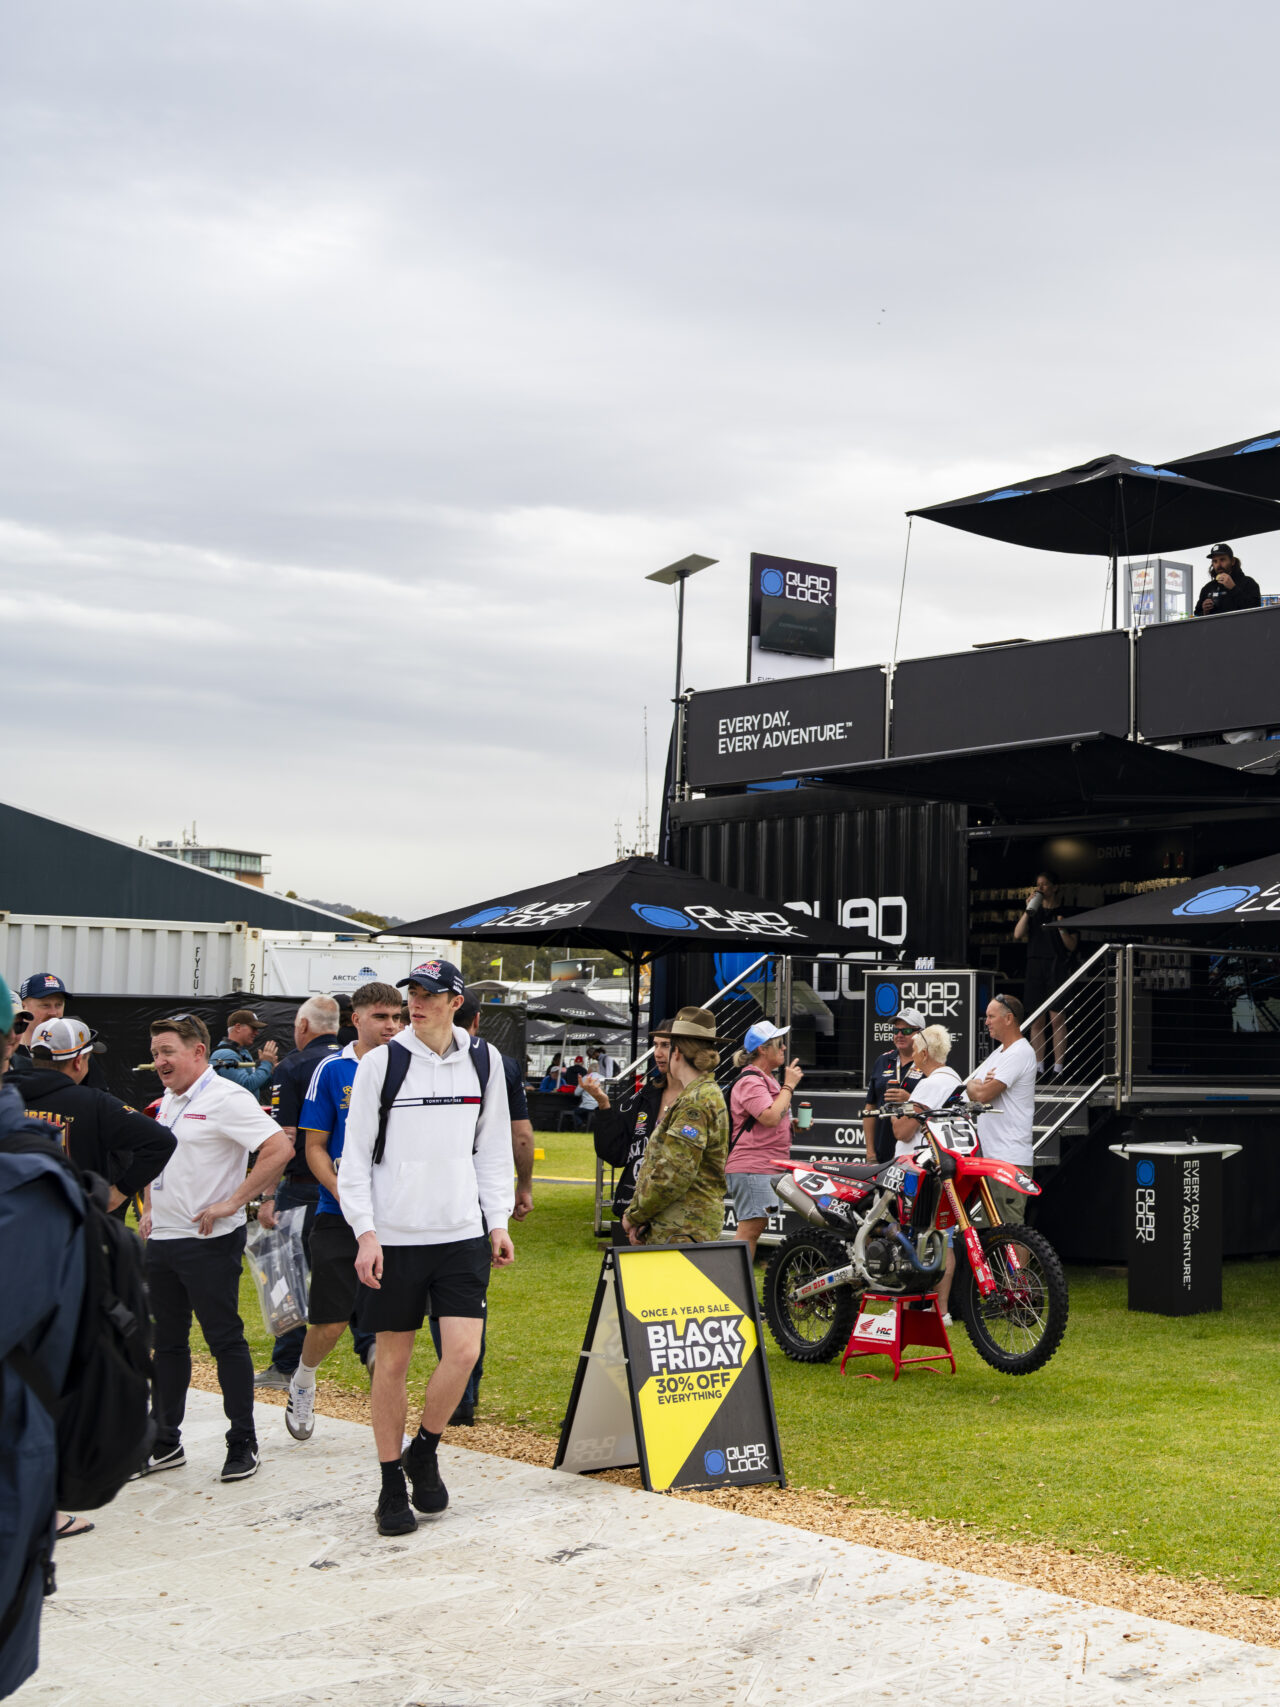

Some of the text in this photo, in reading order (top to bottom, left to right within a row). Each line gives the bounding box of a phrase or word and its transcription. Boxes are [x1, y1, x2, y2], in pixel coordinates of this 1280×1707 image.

[786, 571, 830, 591] QUAD
[785, 585, 831, 605] LOCK
[718, 710, 790, 735] EVERY DAY.
[718, 734, 760, 754] EVERY
[1097, 845, 1132, 858] DRIVE
[512, 901, 591, 914] QUAD
[683, 905, 790, 926] QUAD
[480, 913, 568, 927] LOCK
[698, 918, 808, 938] LOCK
[901, 982, 959, 999] QUAD
[874, 1023, 894, 1032] EVER
[874, 1032, 894, 1041] EVER
[941, 1123, 974, 1149] 15
[796, 1172, 829, 1192] 15
[886, 1166, 905, 1181] QUAD
[1183, 1160, 1191, 1202] EVERY
[882, 1176, 902, 1192] LOCK
[1136, 1188, 1146, 1241] LOCK
[1145, 1189, 1155, 1241] QUAD
[1191, 1204, 1199, 1231] DAY.
[641, 1303, 730, 1318] ONCE A YEAR SALE
[647, 1319, 742, 1349] BLACK
[876, 1327, 892, 1335] HRC
[650, 1342, 742, 1372] FRIDAY
[655, 1372, 731, 1395] 30% OFF
[658, 1390, 722, 1405] EVERYTHING
[726, 1443, 766, 1460] QUAD
[727, 1456, 769, 1474] LOCK
